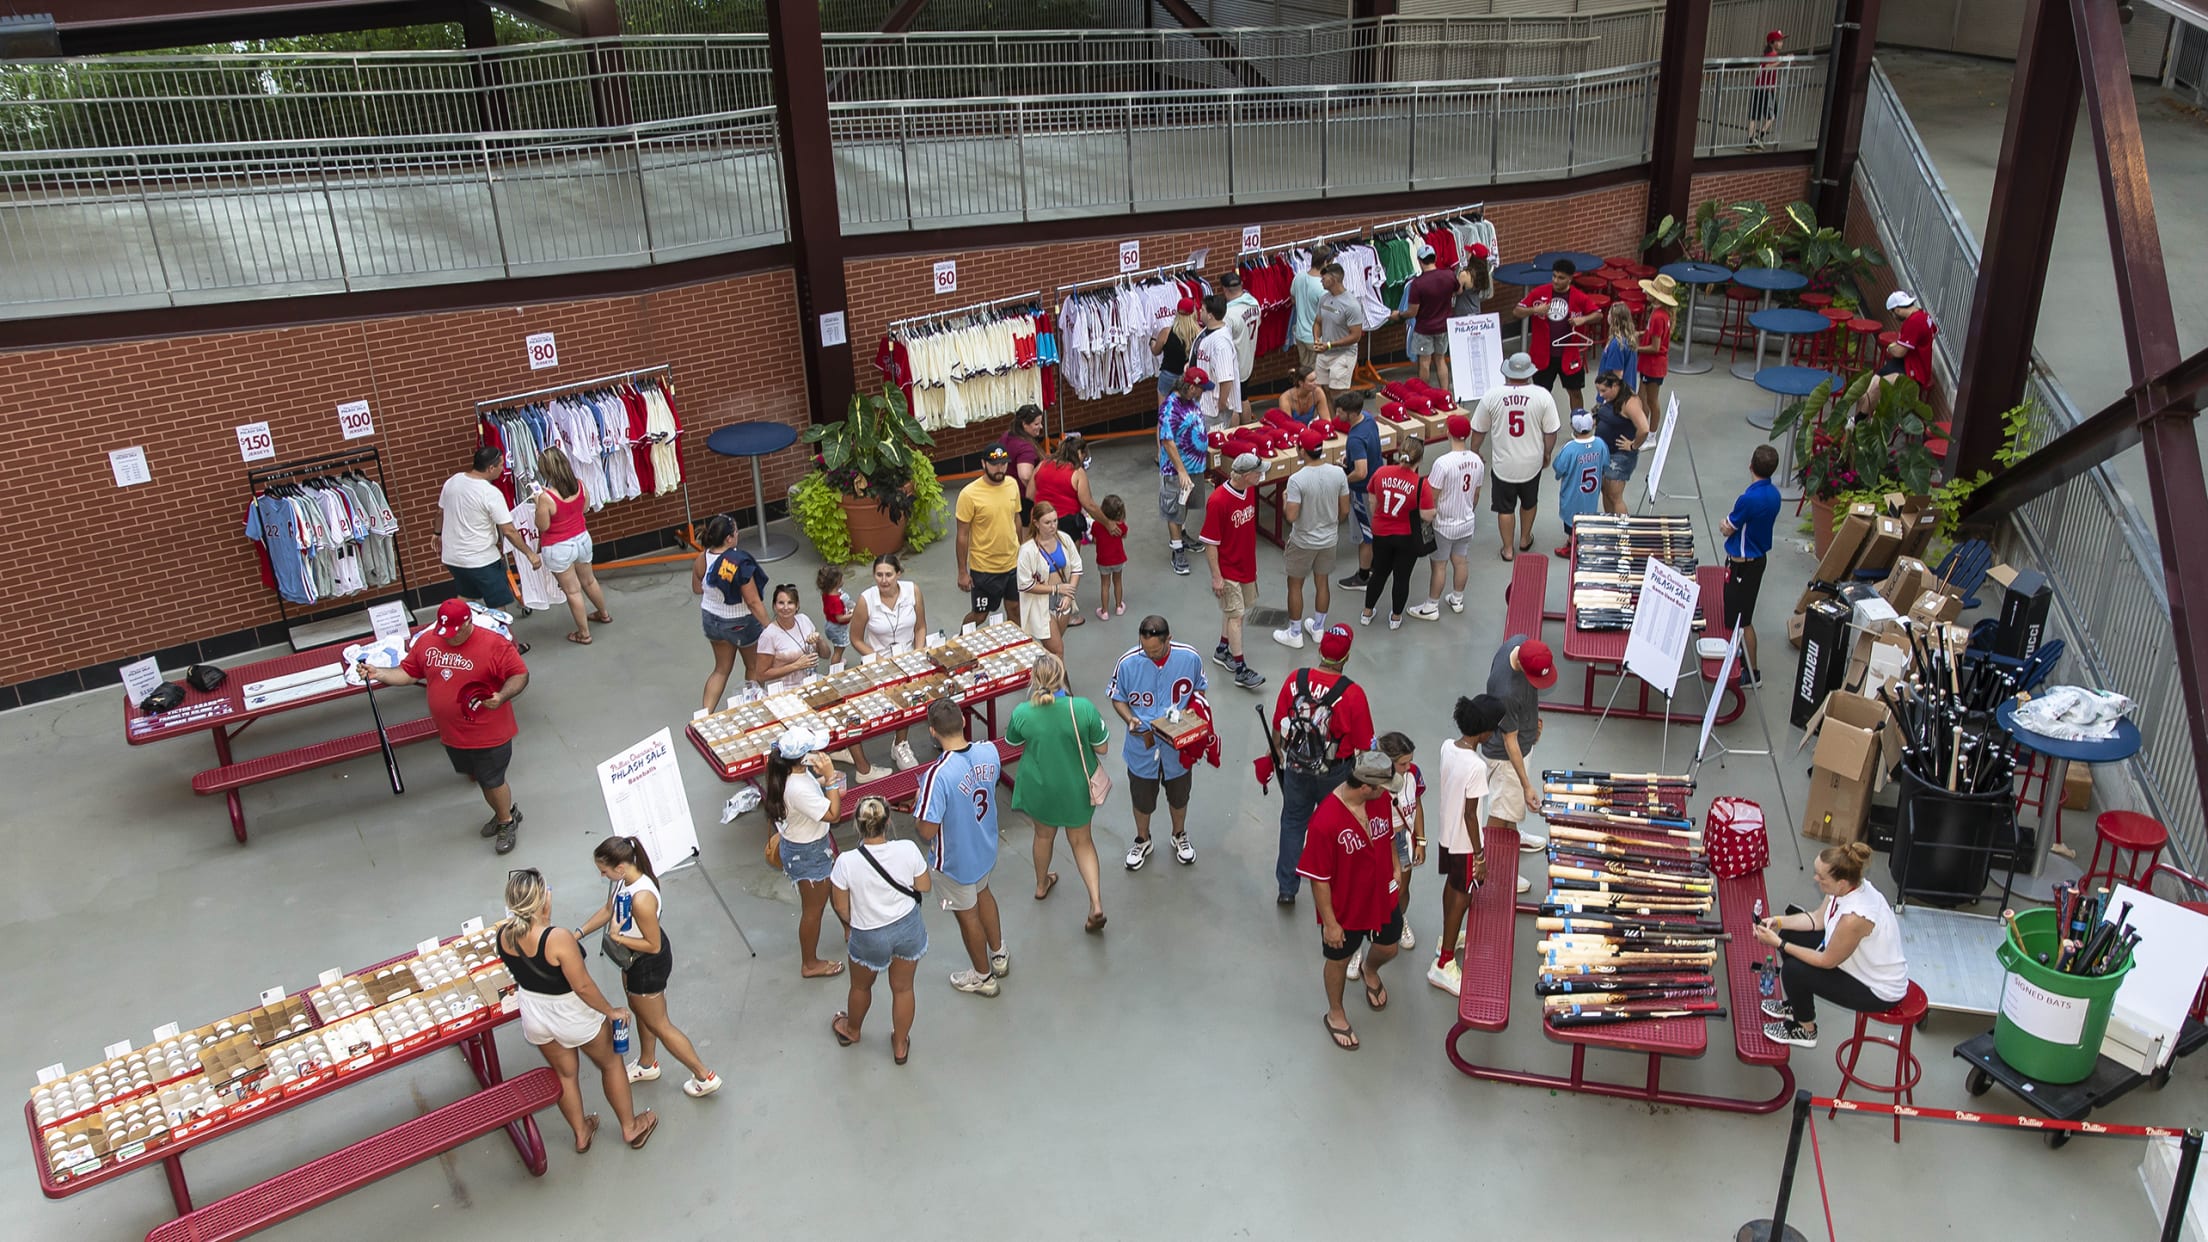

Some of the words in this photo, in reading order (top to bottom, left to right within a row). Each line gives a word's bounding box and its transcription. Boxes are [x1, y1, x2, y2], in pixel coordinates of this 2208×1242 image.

[935, 270, 955, 286] $60
[1455, 325, 1479, 334] PHLASH
[1480, 322, 1495, 330] SALE
[529, 343, 555, 361] $80
[1503, 395, 1530, 407] STOTT
[341, 411, 371, 429] $100
[1509, 410, 1524, 437] 5
[240, 433, 270, 451] $150
[1382, 477, 1415, 495] HOSKINS
[1462, 473, 1471, 493] 3
[1580, 467, 1598, 494] 5
[1383, 490, 1407, 517] 17
[266, 524, 279, 538] 22
[1651, 572, 1675, 591] PHLASH
[1675, 587, 1691, 602] SALE
[976, 597, 988, 607] 19
[425, 646, 473, 671] Phillies
[1800, 640, 1820, 704] marucci
[1128, 691, 1154, 708] 29
[1171, 676, 1194, 706] P
[611, 758, 644, 784] PHLASH
[646, 745, 667, 764] SALE
[628, 766, 656, 785] Baseballs
[957, 764, 996, 797] HARPER
[972, 787, 990, 824] 3
[2014, 976, 2044, 1001] SIGNED
[2046, 996, 2072, 1010] BATS
[1833, 1099, 1858, 1111] Phillies
[1894, 1105, 1919, 1116] Phillies
[1955, 1110, 1981, 1122] Phillies
[2018, 1116, 2044, 1128] Phillies
[2081, 1121, 2107, 1133] Phillies
[2145, 1126, 2172, 1136] Phillies
